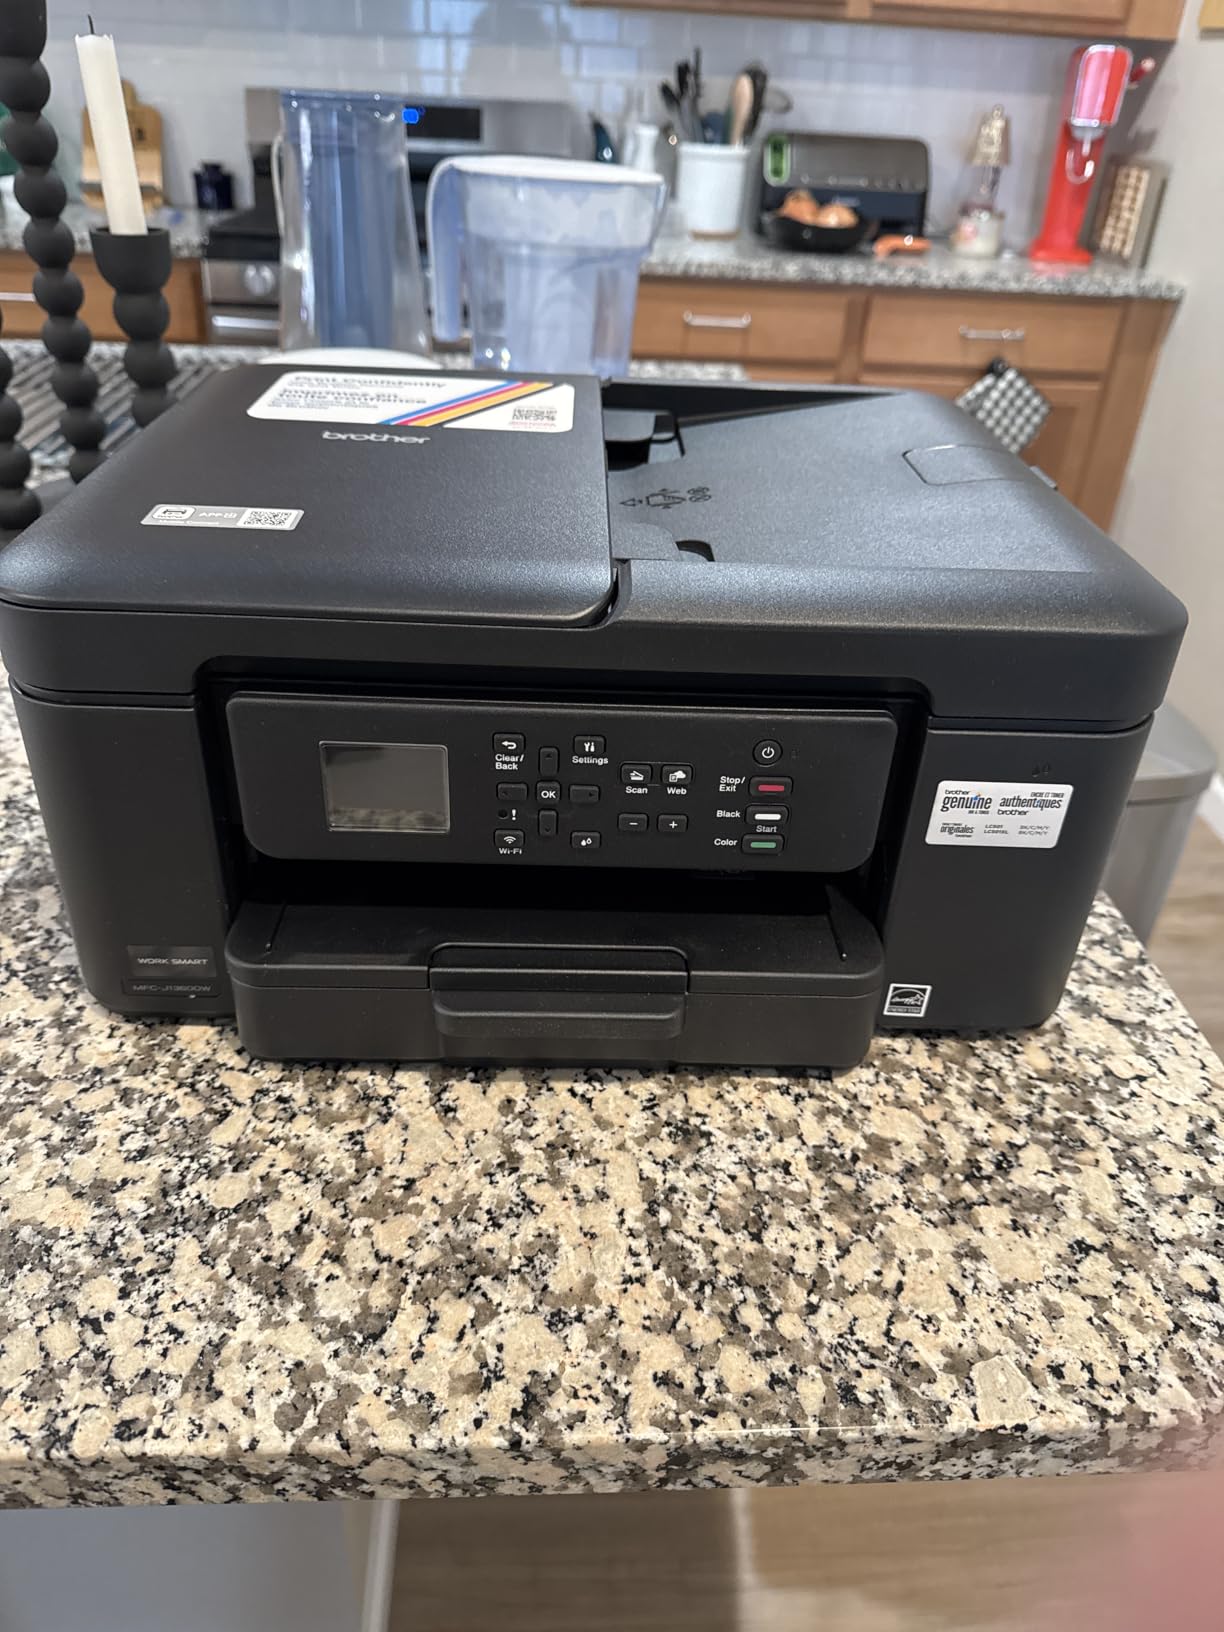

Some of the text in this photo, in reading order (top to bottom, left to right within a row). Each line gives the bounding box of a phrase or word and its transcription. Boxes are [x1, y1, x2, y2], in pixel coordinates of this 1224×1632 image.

[322, 431, 430, 444] brother
[495, 753, 524, 762] Clear/
[572, 755, 608, 765] Settings
[495, 762, 518, 770] Back
[720, 776, 745, 785] Stop/
[541, 790, 556, 798] OK
[625, 786, 648, 794] Scan
[667, 787, 687, 795] Web
[940, 794, 992, 812] genuine
[1000, 795, 1062, 811] authentiques
[716, 810, 740, 818] Black
[756, 825, 777, 833] Start
[940, 826, 974, 835] originales
[714, 838, 738, 846] Color
